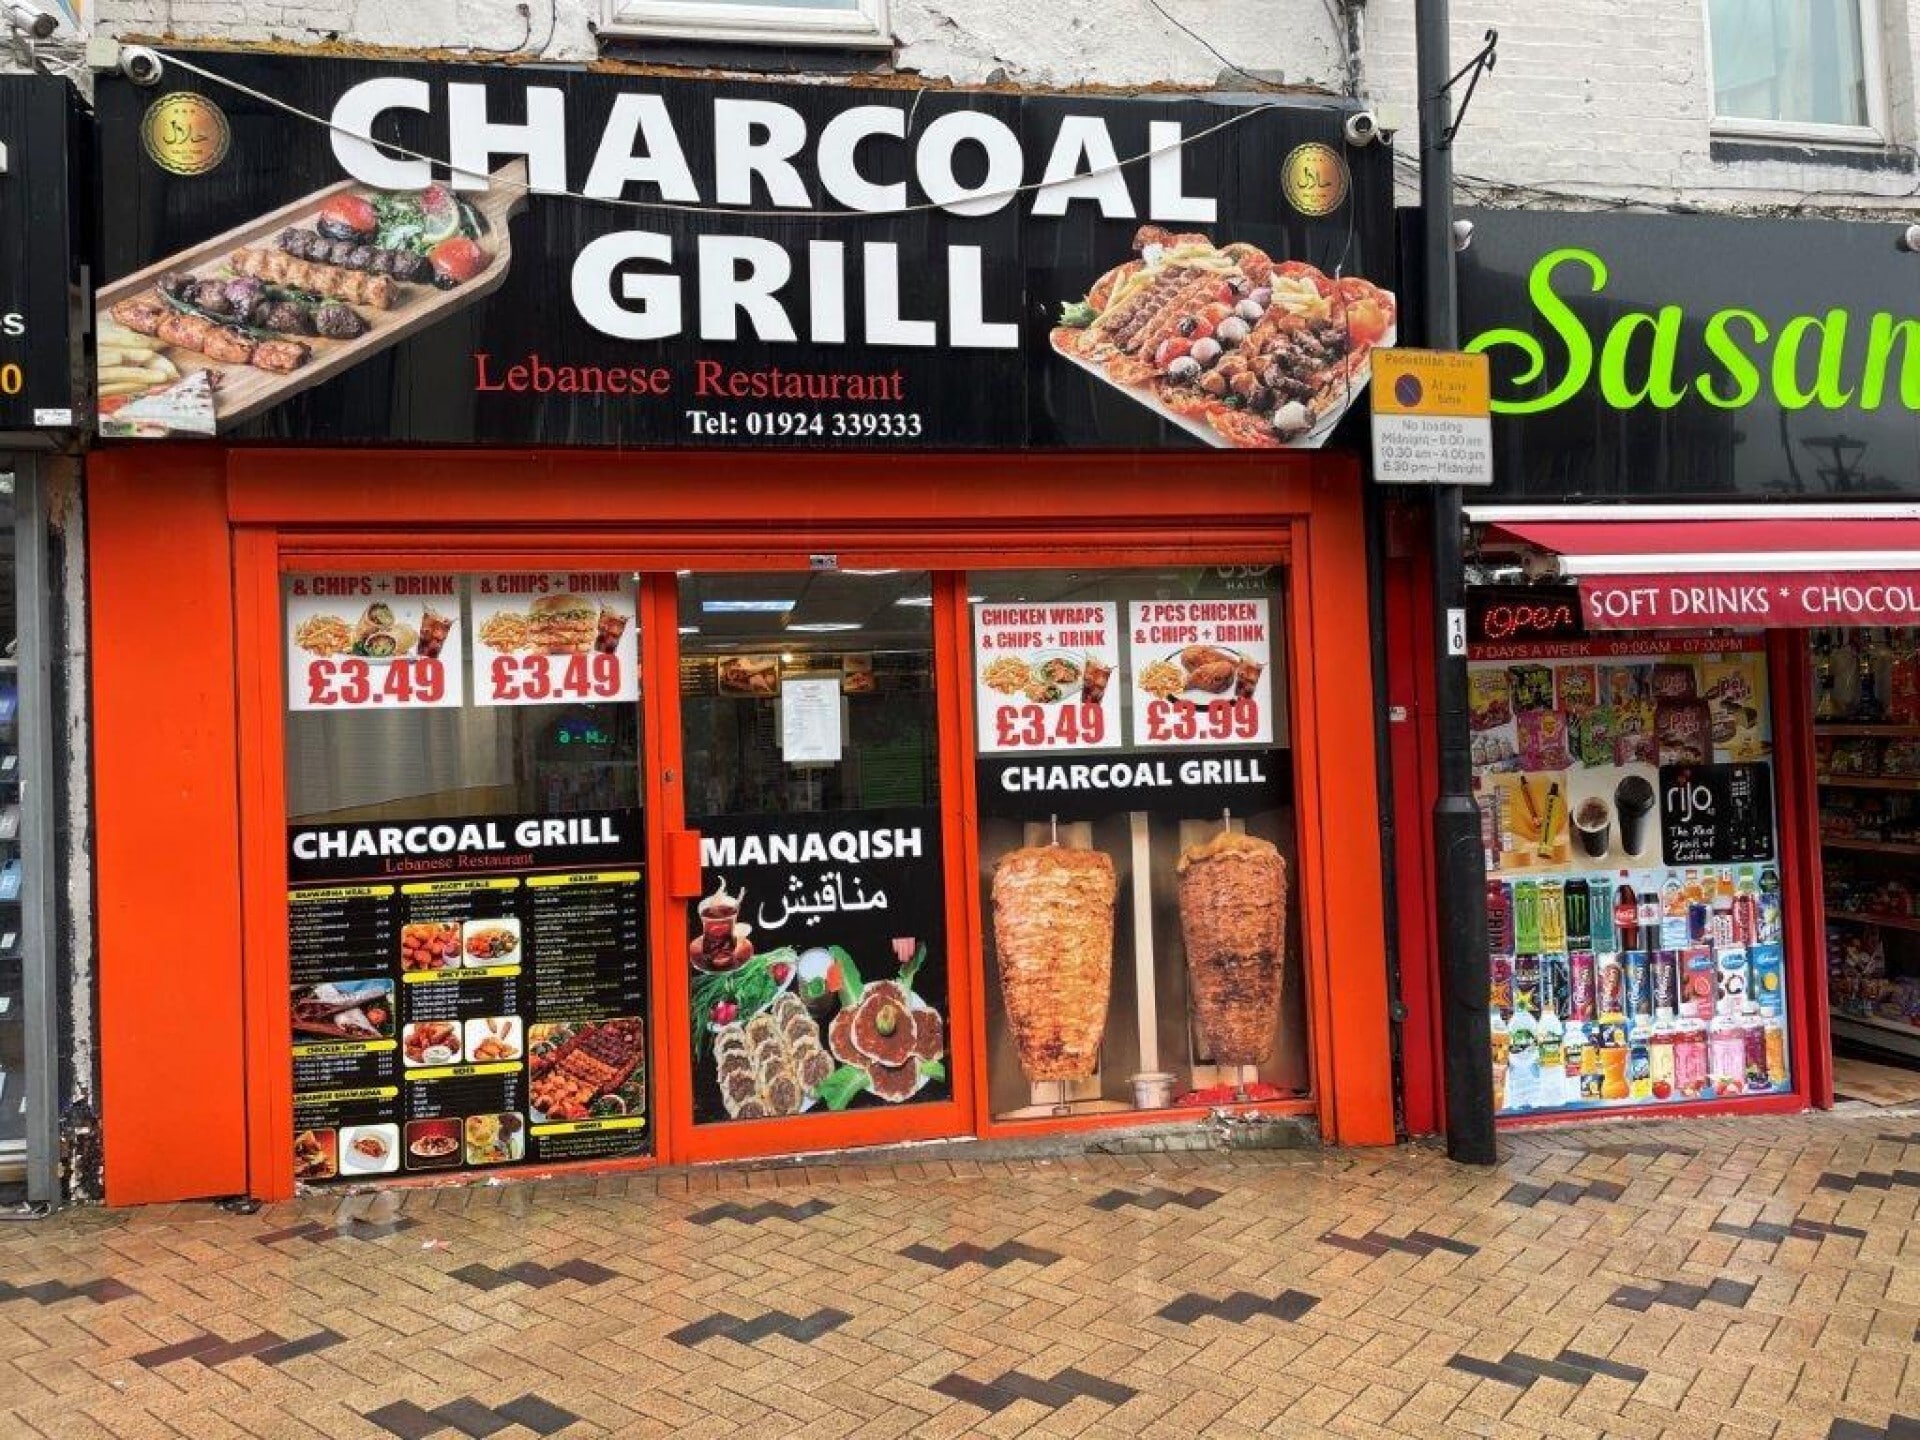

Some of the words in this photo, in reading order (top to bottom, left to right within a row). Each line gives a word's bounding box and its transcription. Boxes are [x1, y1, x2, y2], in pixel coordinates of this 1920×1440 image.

[330, 77, 1217, 222] CHARCOAL
[571, 229, 1018, 348] GRILL
[474, 354, 670, 394] Lebanese
[696, 360, 904, 401] Restaurant
[687, 410, 738, 435] Tel:
[746, 411, 823, 435] 01924
[832, 412, 922, 436] 339333
[1402, 420, 1418, 432] No
[1422, 421, 1464, 435] loading
[312, 576, 373, 596] CHIPS
[395, 574, 455, 595] DRINK
[497, 573, 549, 594] CHIPS
[569, 571, 620, 593] DRINK
[982, 607, 1046, 626] CHICKEN
[1050, 606, 1105, 624] WRAPS
[1141, 606, 1150, 623] 2
[1154, 605, 1186, 622] PCS
[1189, 603, 1257, 621] CHICKEN
[1589, 588, 1660, 619] SOFT
[1671, 586, 1770, 614] DRINKS
[1802, 586, 1920, 612] CHOCOL
[996, 631, 1041, 648] CHIPS
[1059, 629, 1105, 647] DRINK
[1150, 626, 1198, 644] CHIPS
[1216, 624, 1264, 642] DRINK
[1486, 645, 1527, 659] DAYS
[1532, 645, 1542, 657] A
[1545, 643, 1591, 657] WEEK
[308, 656, 446, 705] £3.49
[491, 653, 621, 701] £3.49
[996, 704, 1106, 747] £3.49
[1147, 699, 1259, 740] £3.99
[1001, 762, 1173, 792] CHARCOAL
[1179, 759, 1266, 785] GRILL
[292, 823, 506, 860] CHARCOAL
[514, 816, 621, 848] GRILL
[700, 828, 922, 867] MANAQISH
[385, 857, 453, 873] Lebanese
[458, 854, 534, 868] Restaurant
[758, 871, 888, 930] مناقيش
